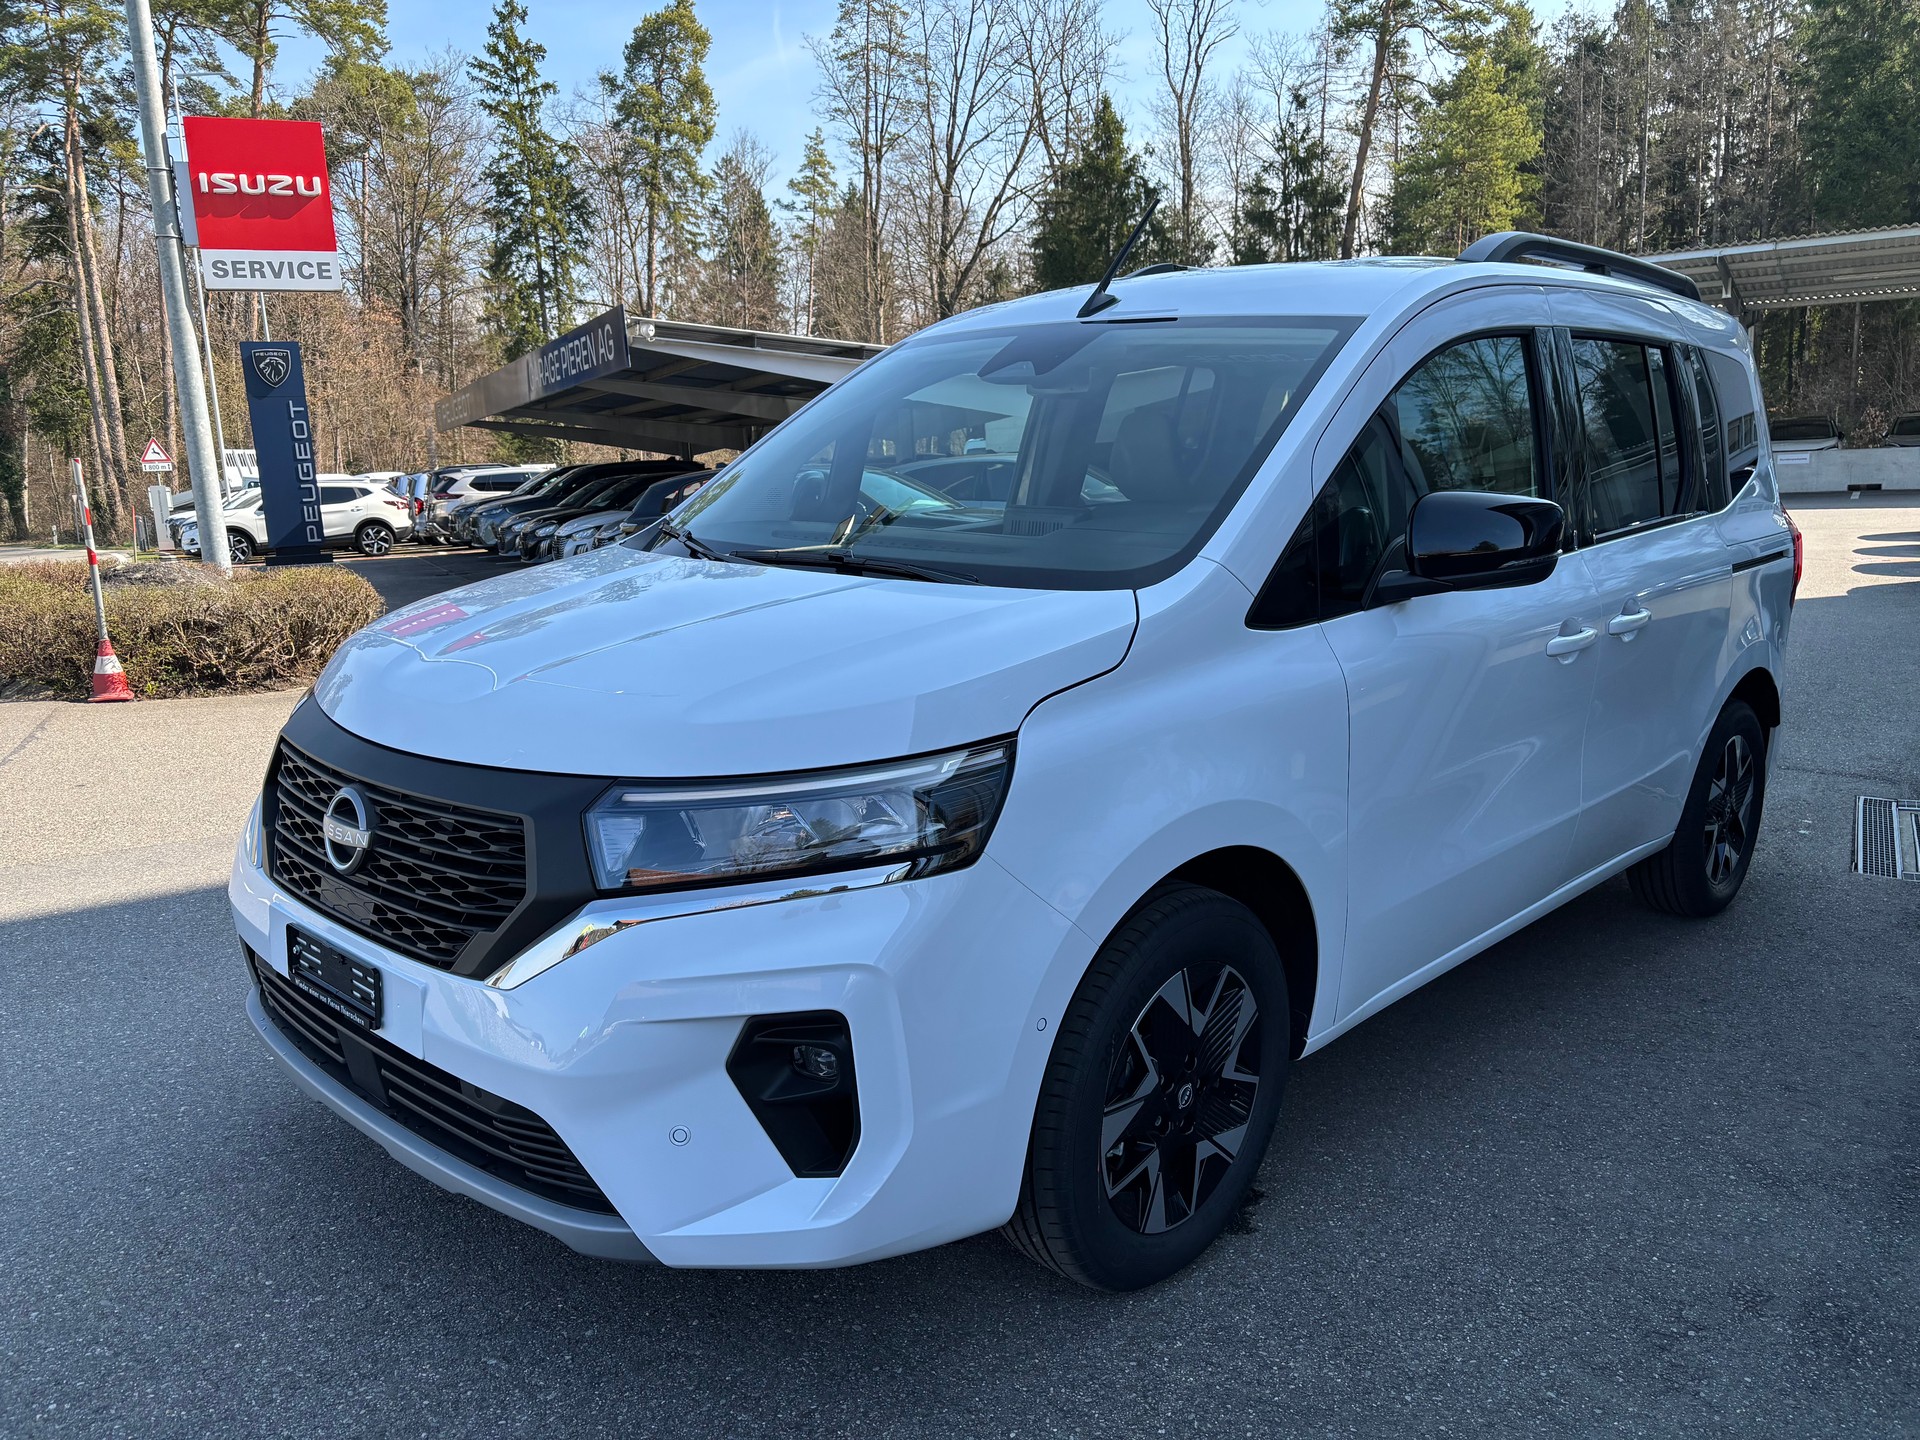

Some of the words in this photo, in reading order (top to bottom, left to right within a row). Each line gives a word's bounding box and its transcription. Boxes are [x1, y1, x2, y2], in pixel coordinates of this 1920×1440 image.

[198, 172, 322, 197] ISUZU
[212, 260, 333, 280] SERVICE
[529, 350, 561, 392] GARAGE
[560, 331, 597, 379] PIEREN
[598, 323, 615, 364] AG
[289, 400, 322, 542] PEUGEOT
